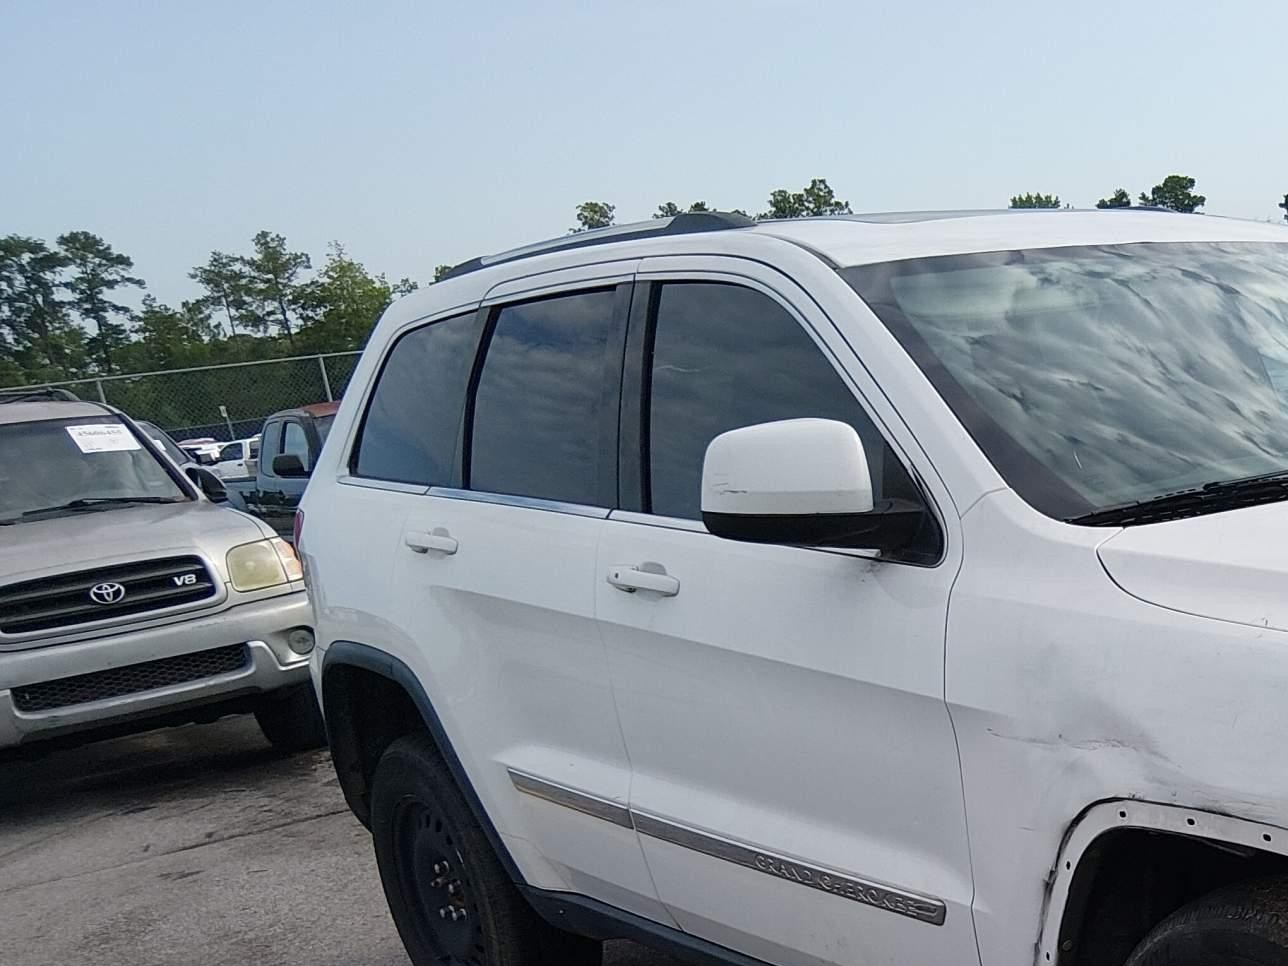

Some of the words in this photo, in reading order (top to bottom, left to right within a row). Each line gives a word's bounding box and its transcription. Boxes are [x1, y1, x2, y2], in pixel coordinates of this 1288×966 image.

[173, 573, 197, 587] V8
[754, 854, 812, 884] GRAND
[817, 875, 918, 917] CHEROKEE
